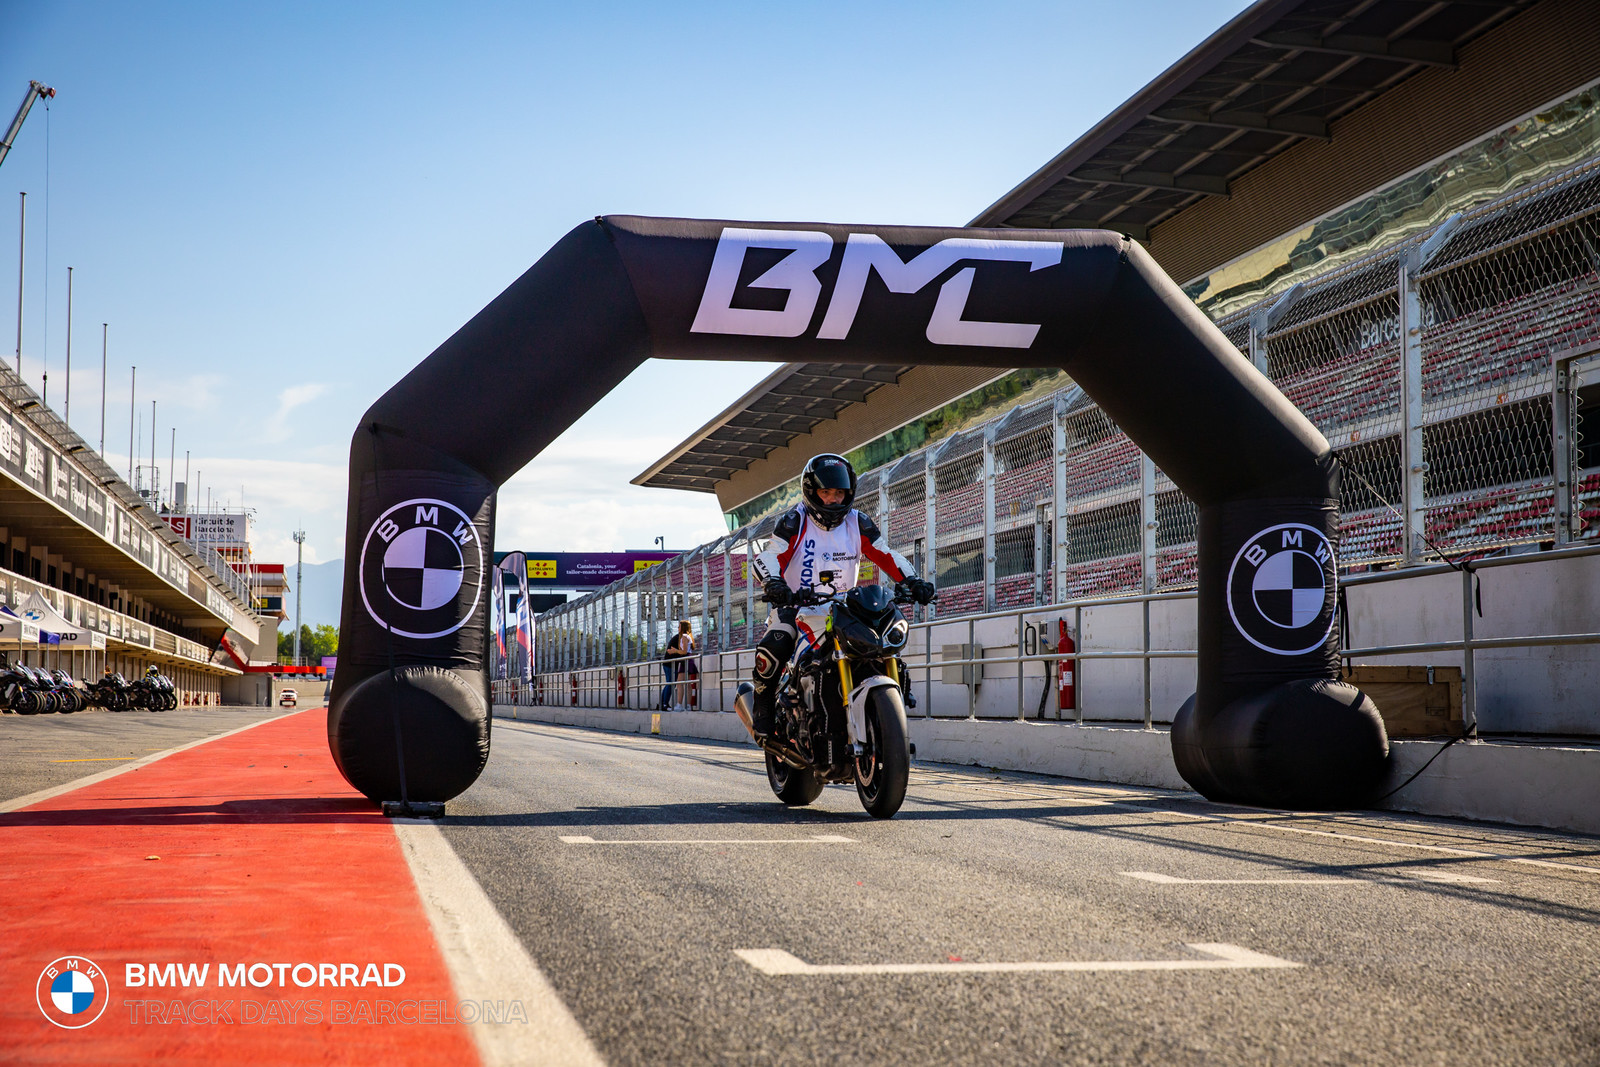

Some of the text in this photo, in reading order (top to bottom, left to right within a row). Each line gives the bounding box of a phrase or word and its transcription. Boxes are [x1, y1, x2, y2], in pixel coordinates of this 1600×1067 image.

[690, 227, 1064, 348] BMC
[195, 517, 223, 525] Circuit
[376, 506, 474, 546] BMW
[1244, 530, 1330, 567] BMW
